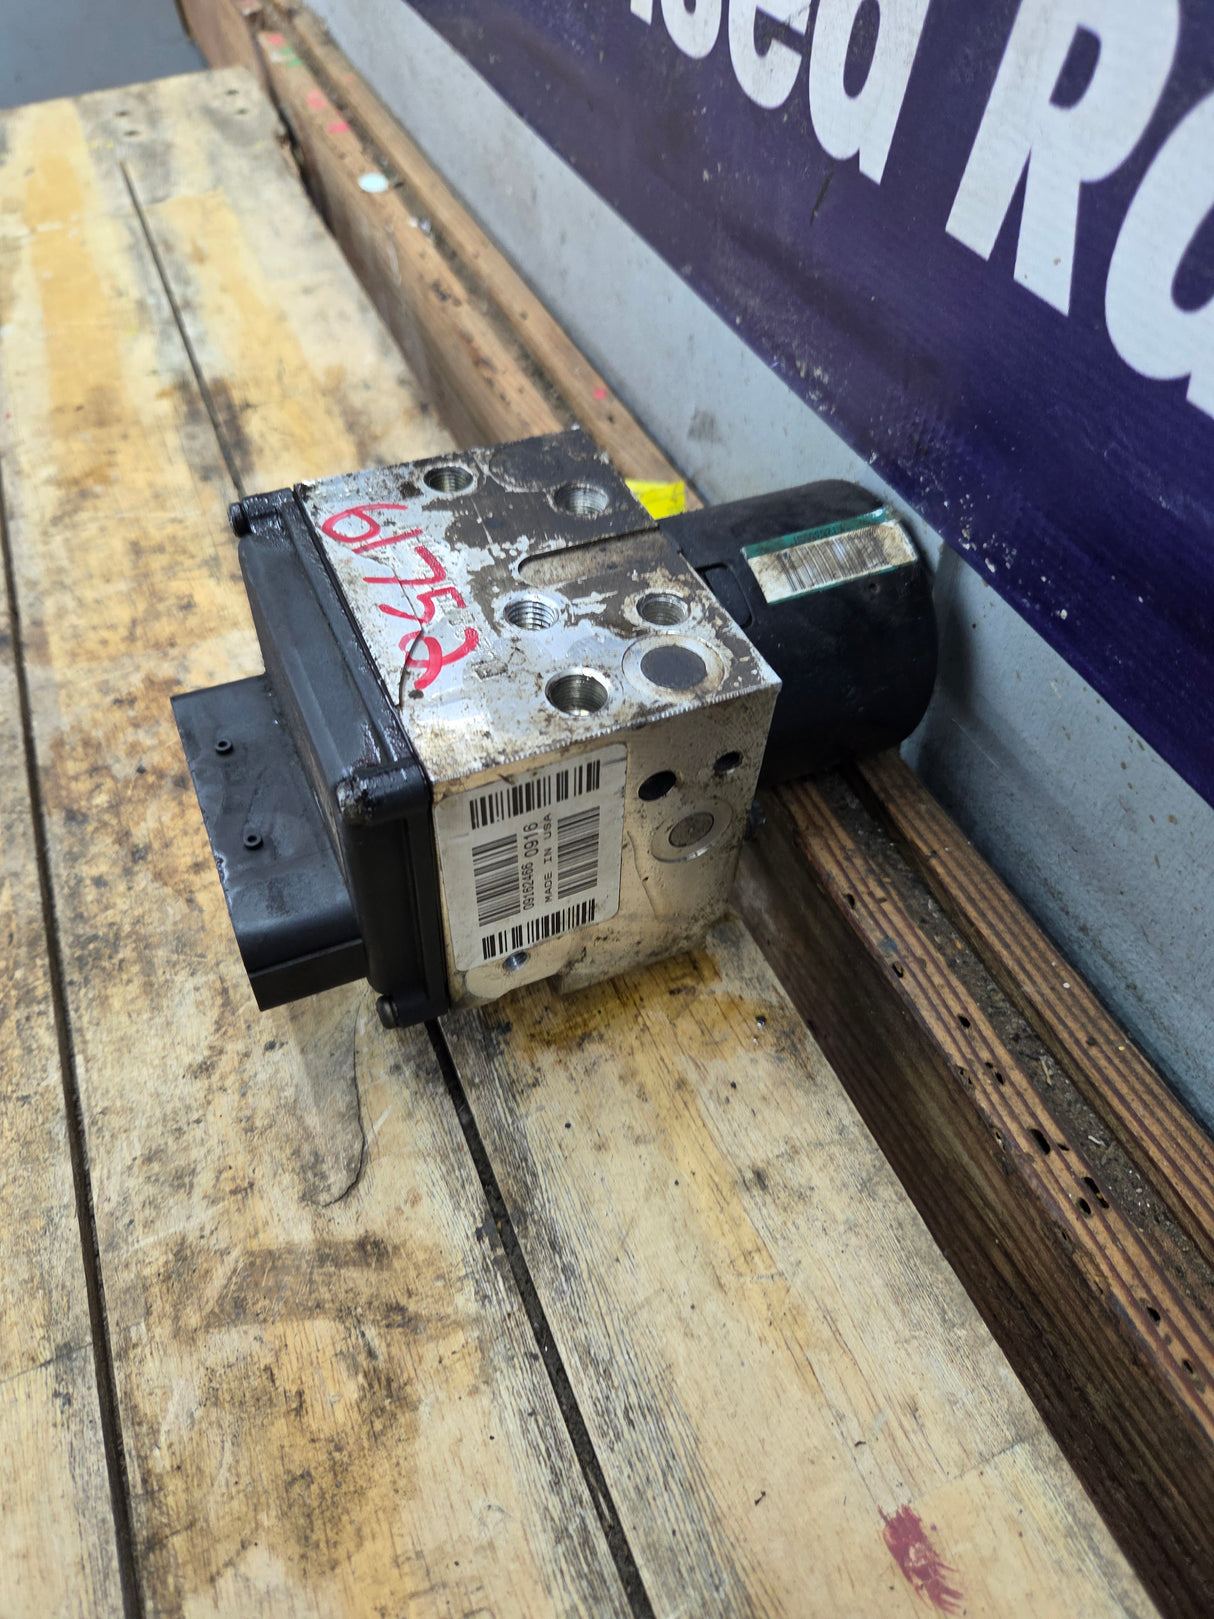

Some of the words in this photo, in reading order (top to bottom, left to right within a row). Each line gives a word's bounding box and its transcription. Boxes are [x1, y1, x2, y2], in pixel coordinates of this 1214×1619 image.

[321, 503, 479, 690] 61752
[523, 822, 540, 858] 0916
[543, 812, 552, 840] USA
[543, 847, 553, 864] IN
[544, 871, 553, 903] MADE
